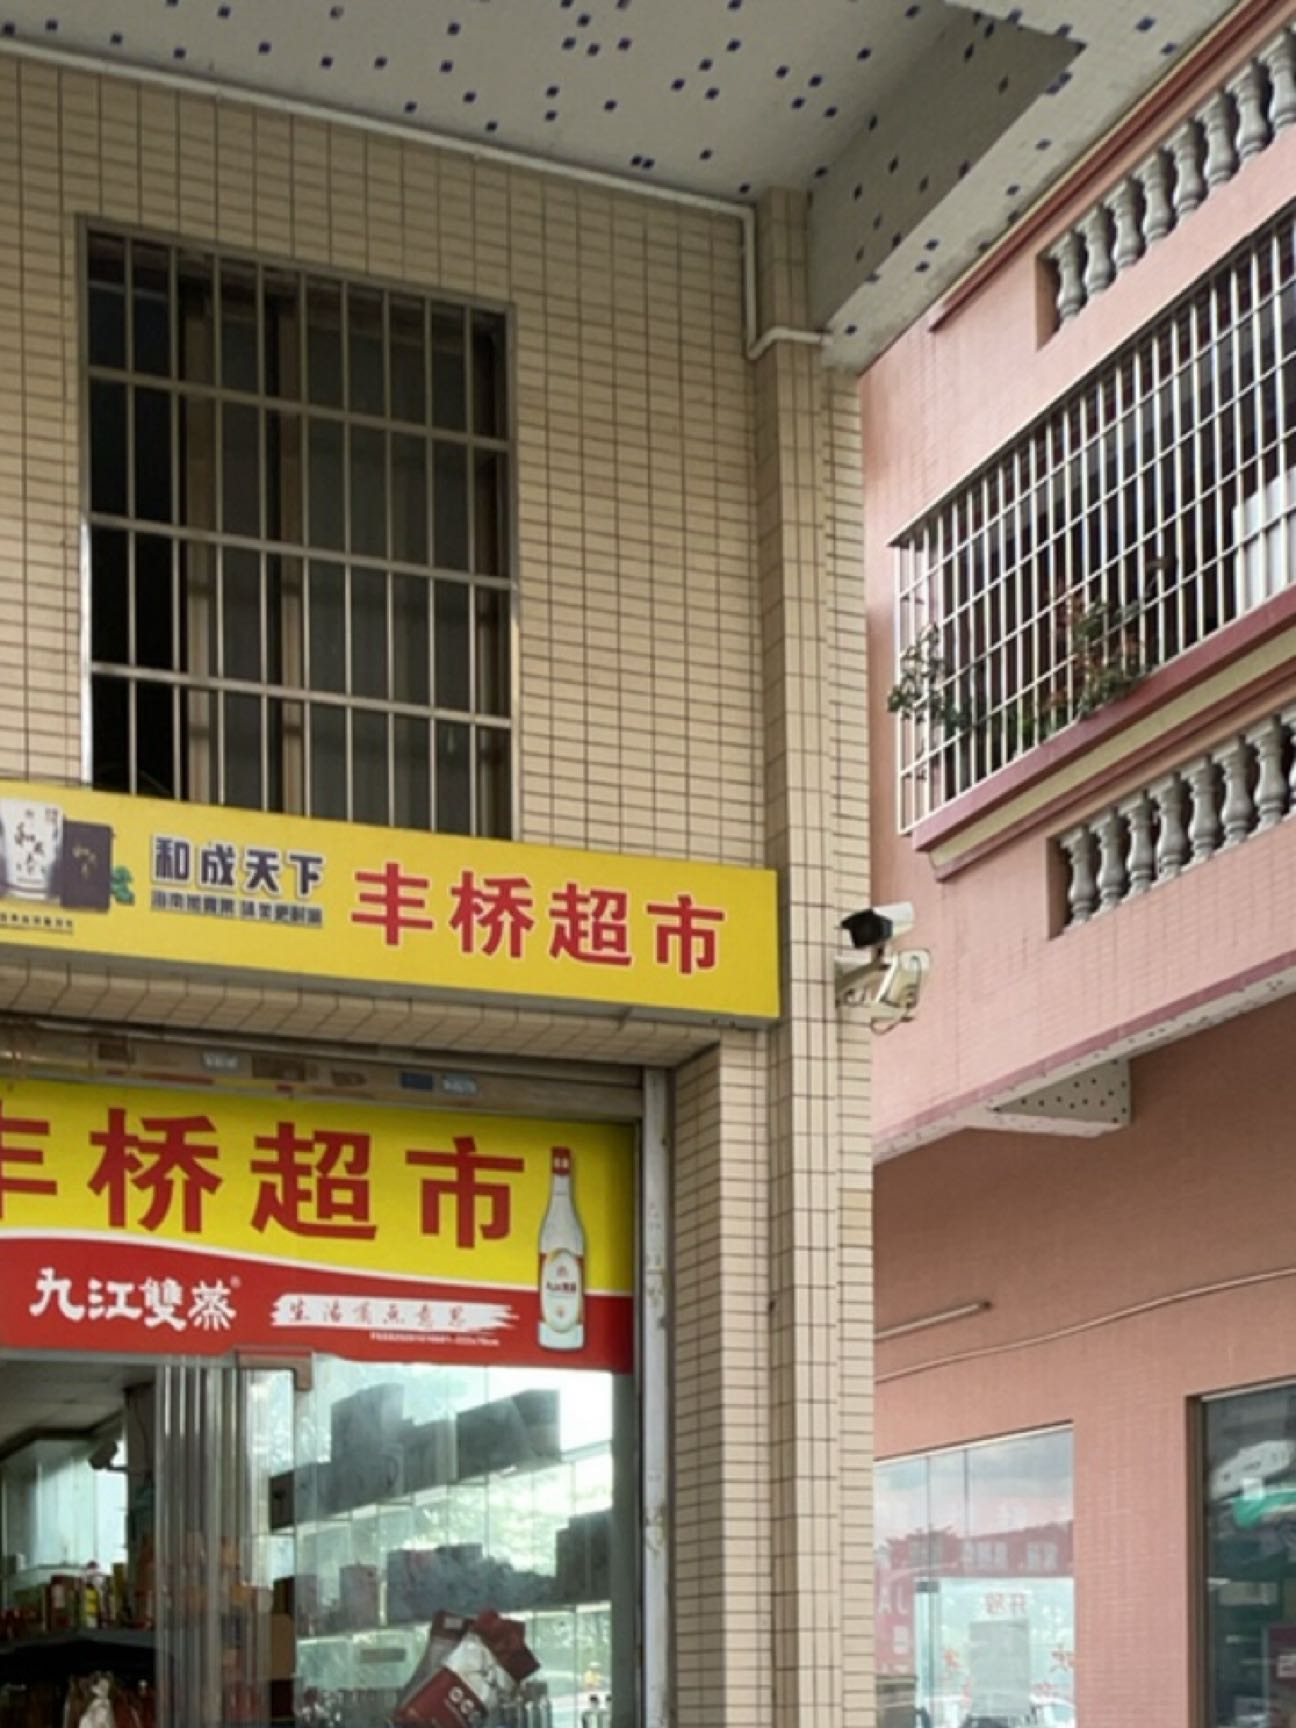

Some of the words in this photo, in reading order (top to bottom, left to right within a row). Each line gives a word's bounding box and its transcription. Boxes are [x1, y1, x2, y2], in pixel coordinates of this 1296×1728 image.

[150, 834, 326, 898] 和成天下
[349, 862, 726, 976] 丰桥超市
